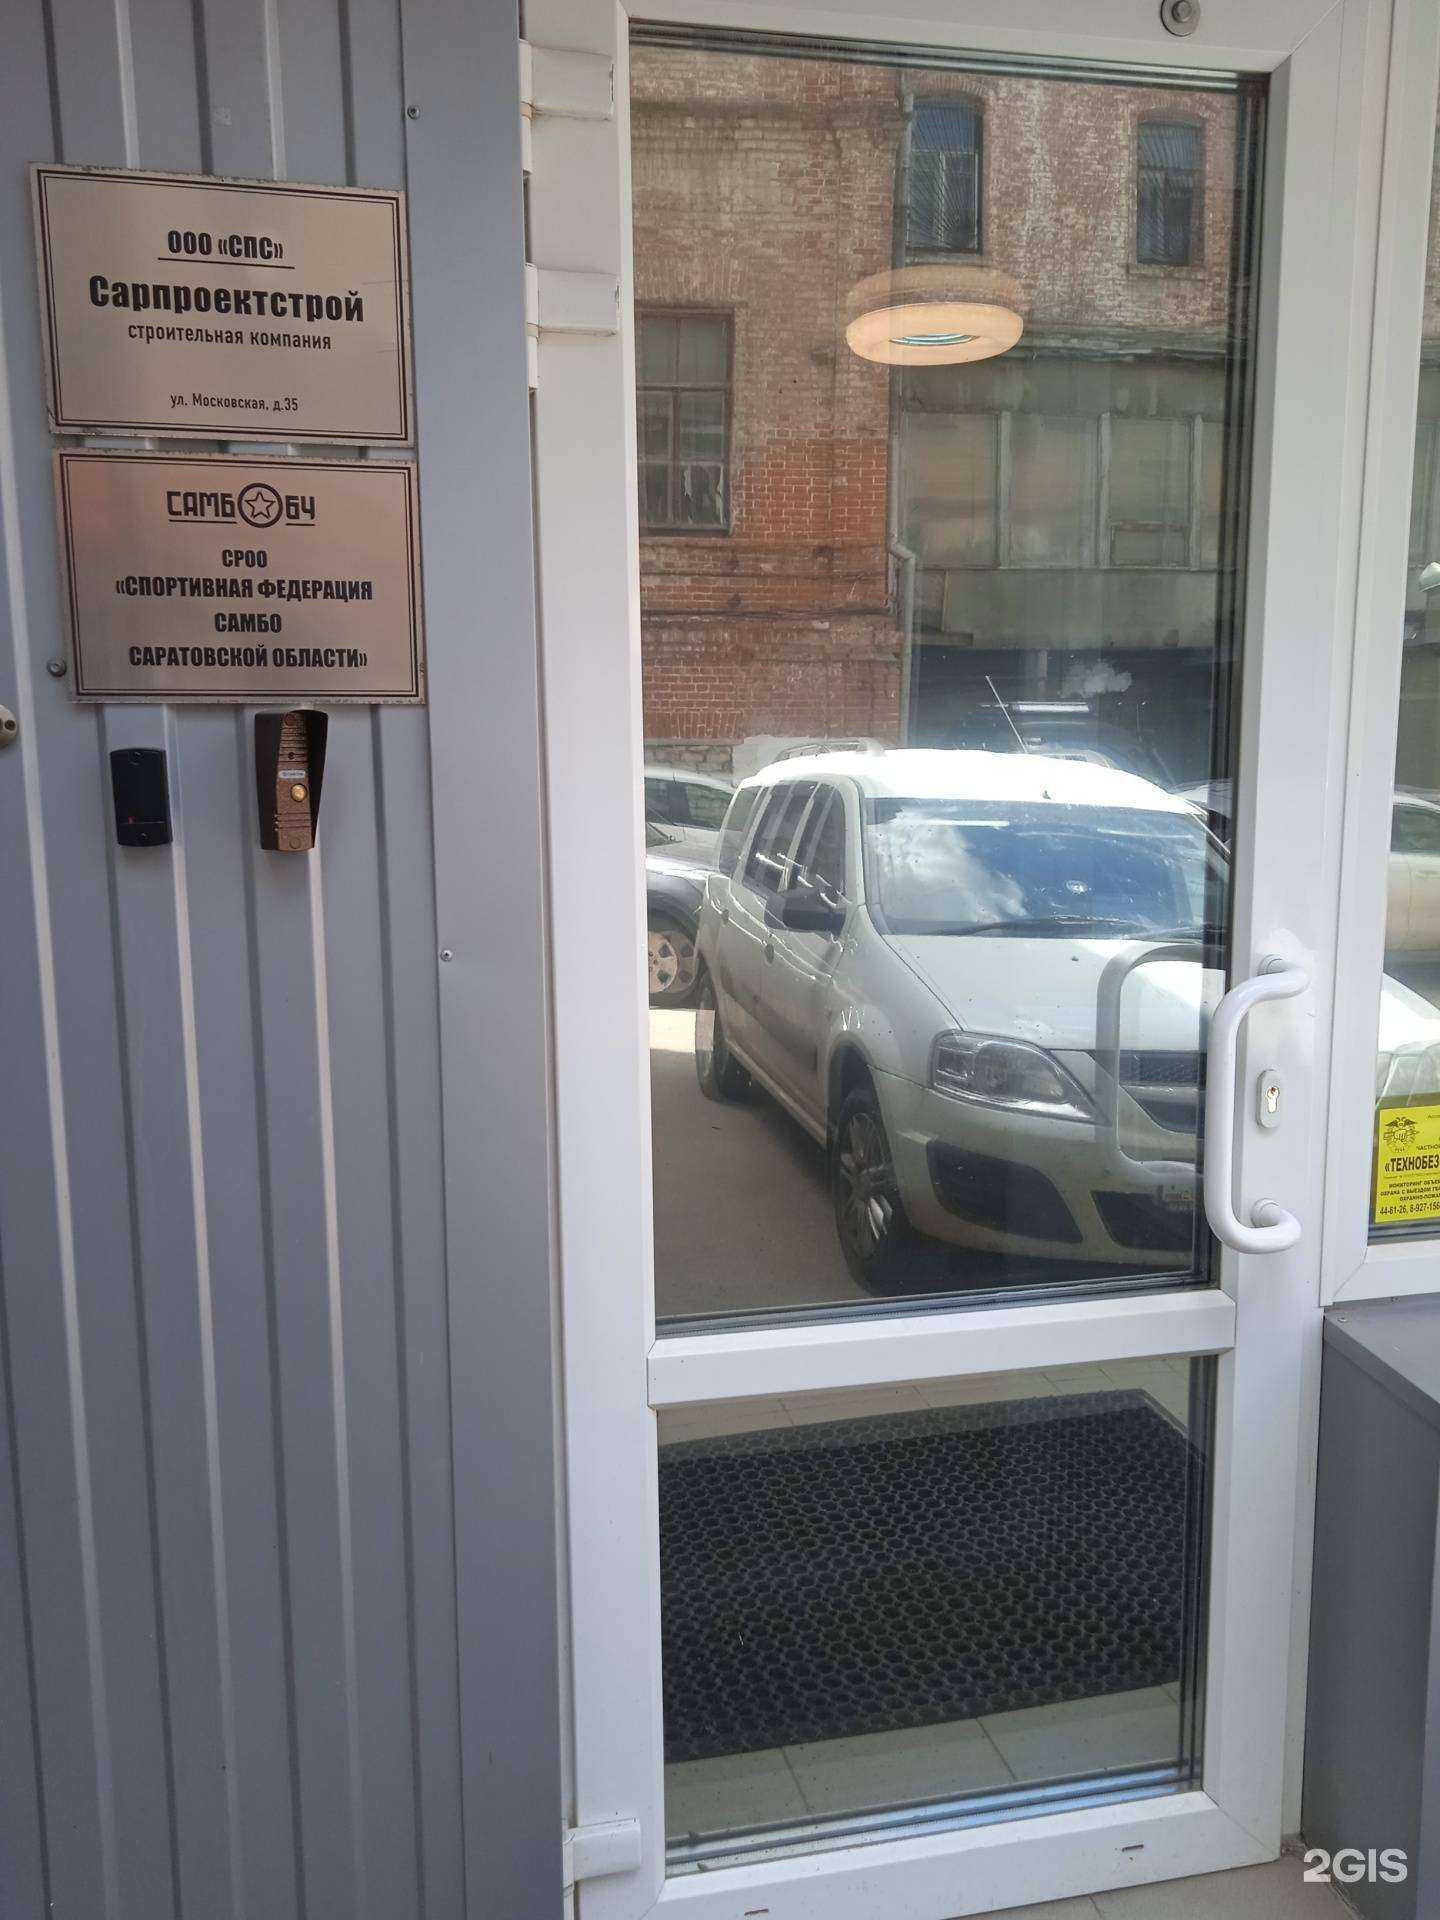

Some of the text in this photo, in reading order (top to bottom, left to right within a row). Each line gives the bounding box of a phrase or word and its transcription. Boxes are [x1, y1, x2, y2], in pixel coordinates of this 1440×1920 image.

[167, 230, 283, 260] ООО «СПС»
[89, 275, 364, 322] Сарпроектстрой
[128, 324, 331, 350] строительная компания
[170, 393, 299, 413] ул. Московская, д.35
[222, 549, 268, 568] СРОО
[116, 576, 373, 602] «СПОРТИВНАЯ ФЕДЕРАЦИЯ
[214, 612, 282, 633] САМБО
[128, 644, 368, 669] САРАТОВСКОЙ ОБЛАСТИ»
